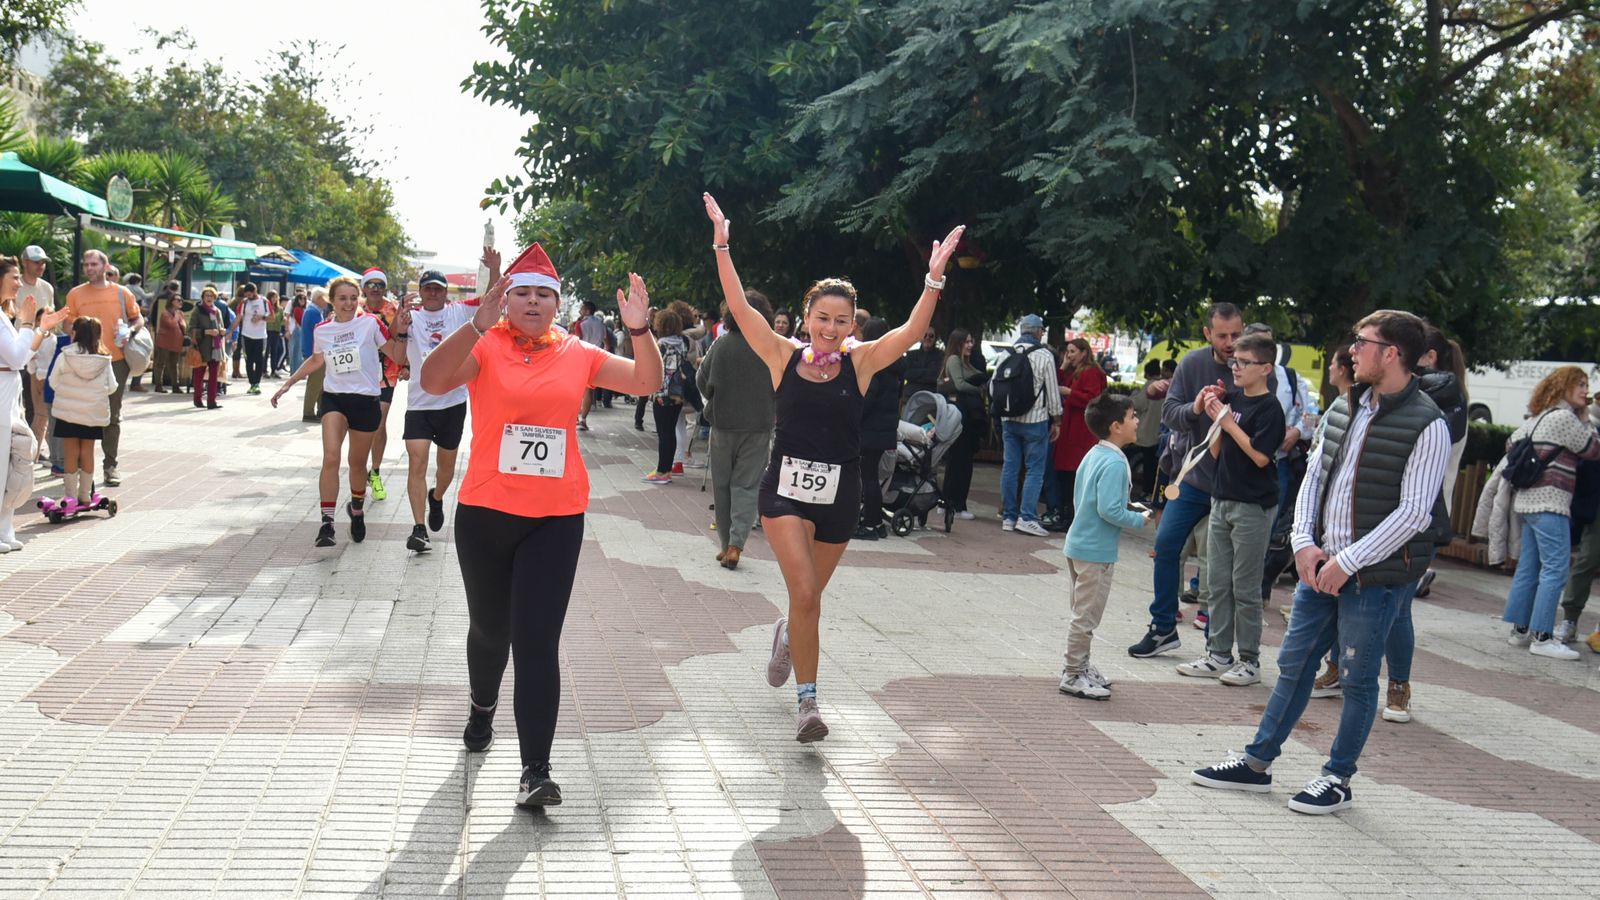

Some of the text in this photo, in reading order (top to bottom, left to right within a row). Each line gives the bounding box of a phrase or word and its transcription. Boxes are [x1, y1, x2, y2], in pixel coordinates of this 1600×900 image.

[333, 353, 353, 366] 120
[534, 427, 563, 435] SILVESTRE
[520, 440, 548, 461] 70
[791, 471, 827, 492] 159
